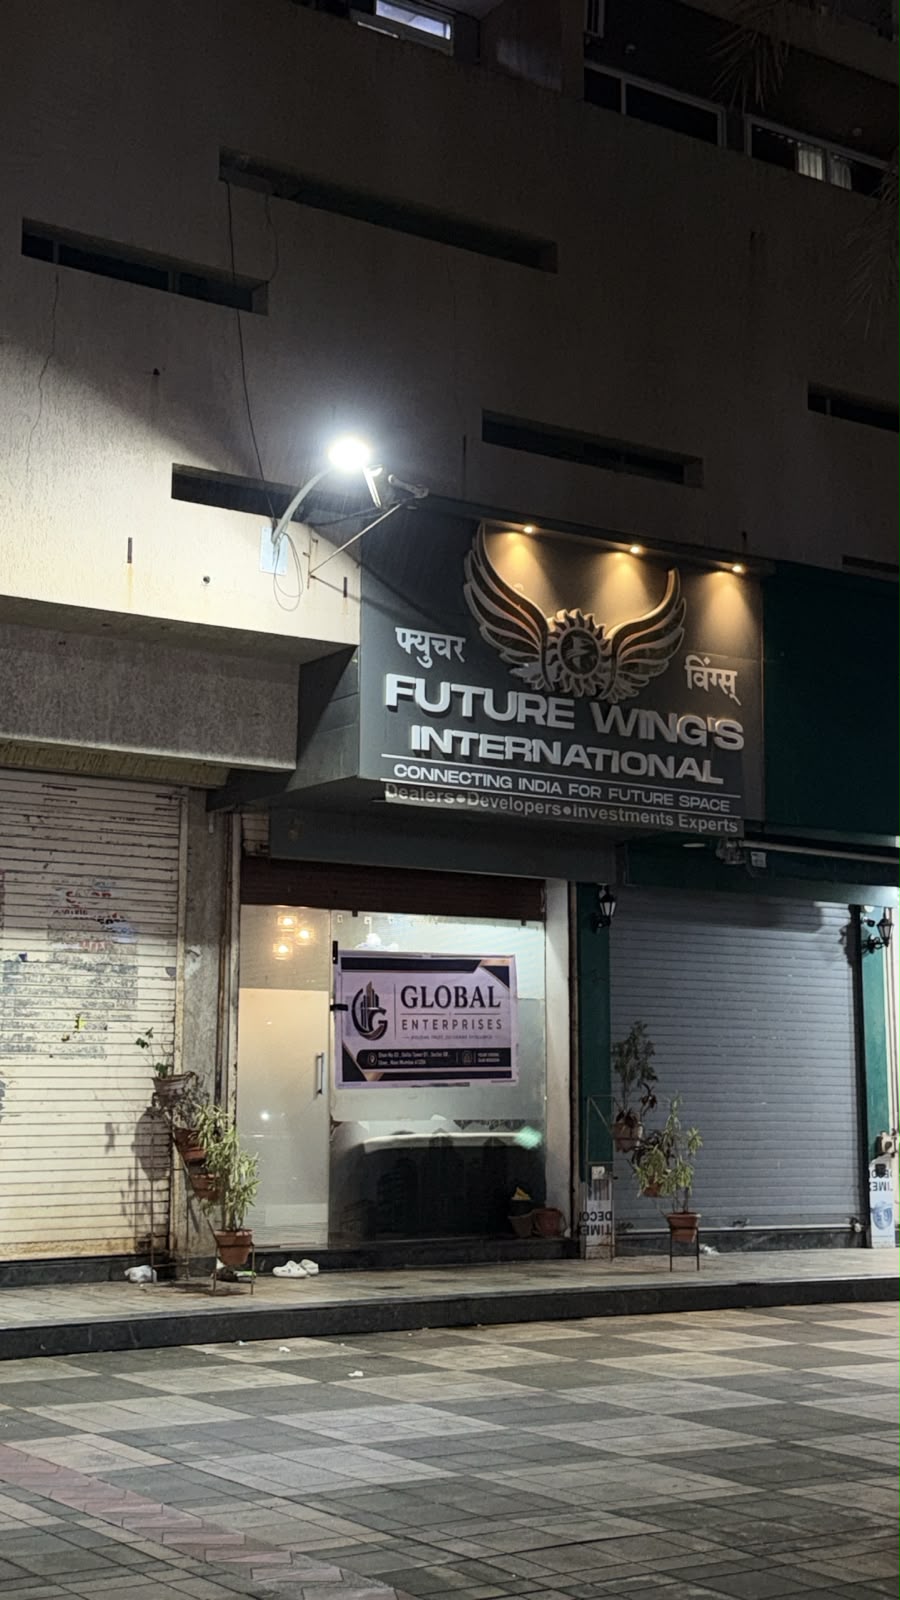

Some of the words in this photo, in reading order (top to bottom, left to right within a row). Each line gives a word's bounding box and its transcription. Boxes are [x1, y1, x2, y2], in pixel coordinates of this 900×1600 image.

[384, 673, 575, 730] FUTURE
[591, 702, 744, 751] WING'S
[410, 725, 724, 785] INTERNATIONAL
[394, 764, 512, 789] CONNECTING
[519, 778, 562, 794] INDIA
[568, 783, 602, 799] FOR
[608, 788, 674, 805] FUTURE
[679, 796, 730, 812] SPACE
[679, 814, 738, 833] Experts
[400, 985, 501, 1009] GLOBAL
[402, 1018, 502, 1031] ENTERPRISES
[579, 1224, 612, 1236] TIME
